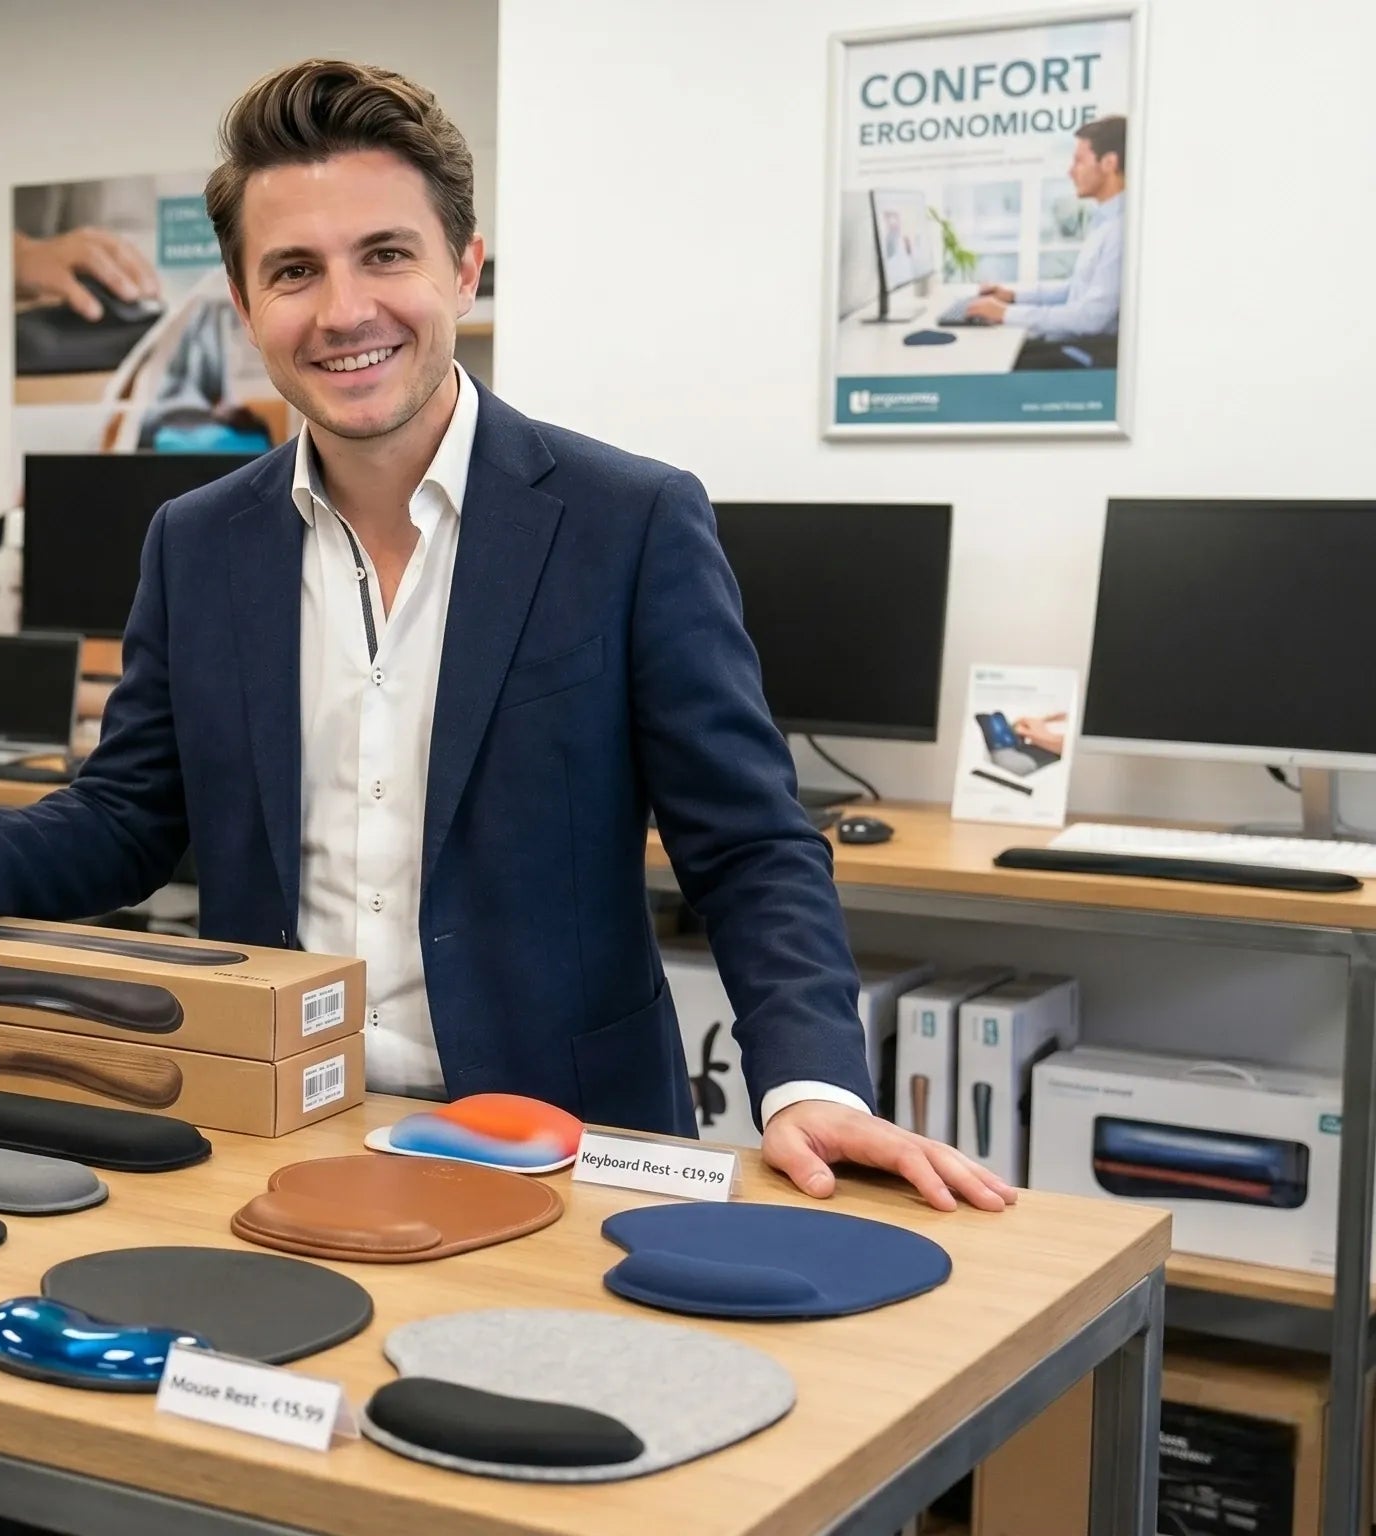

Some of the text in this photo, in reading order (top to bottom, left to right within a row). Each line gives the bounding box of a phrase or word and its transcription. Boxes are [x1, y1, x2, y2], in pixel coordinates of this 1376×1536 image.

[860, 53, 1101, 109] CONFORT
[581, 1151, 640, 1171] Keyboard
[642, 1161, 671, 1176] Rest
[682, 1167, 725, 1184] €19,99
[170, 1376, 220, 1400] Mouse
[224, 1386, 257, 1409] Rest
